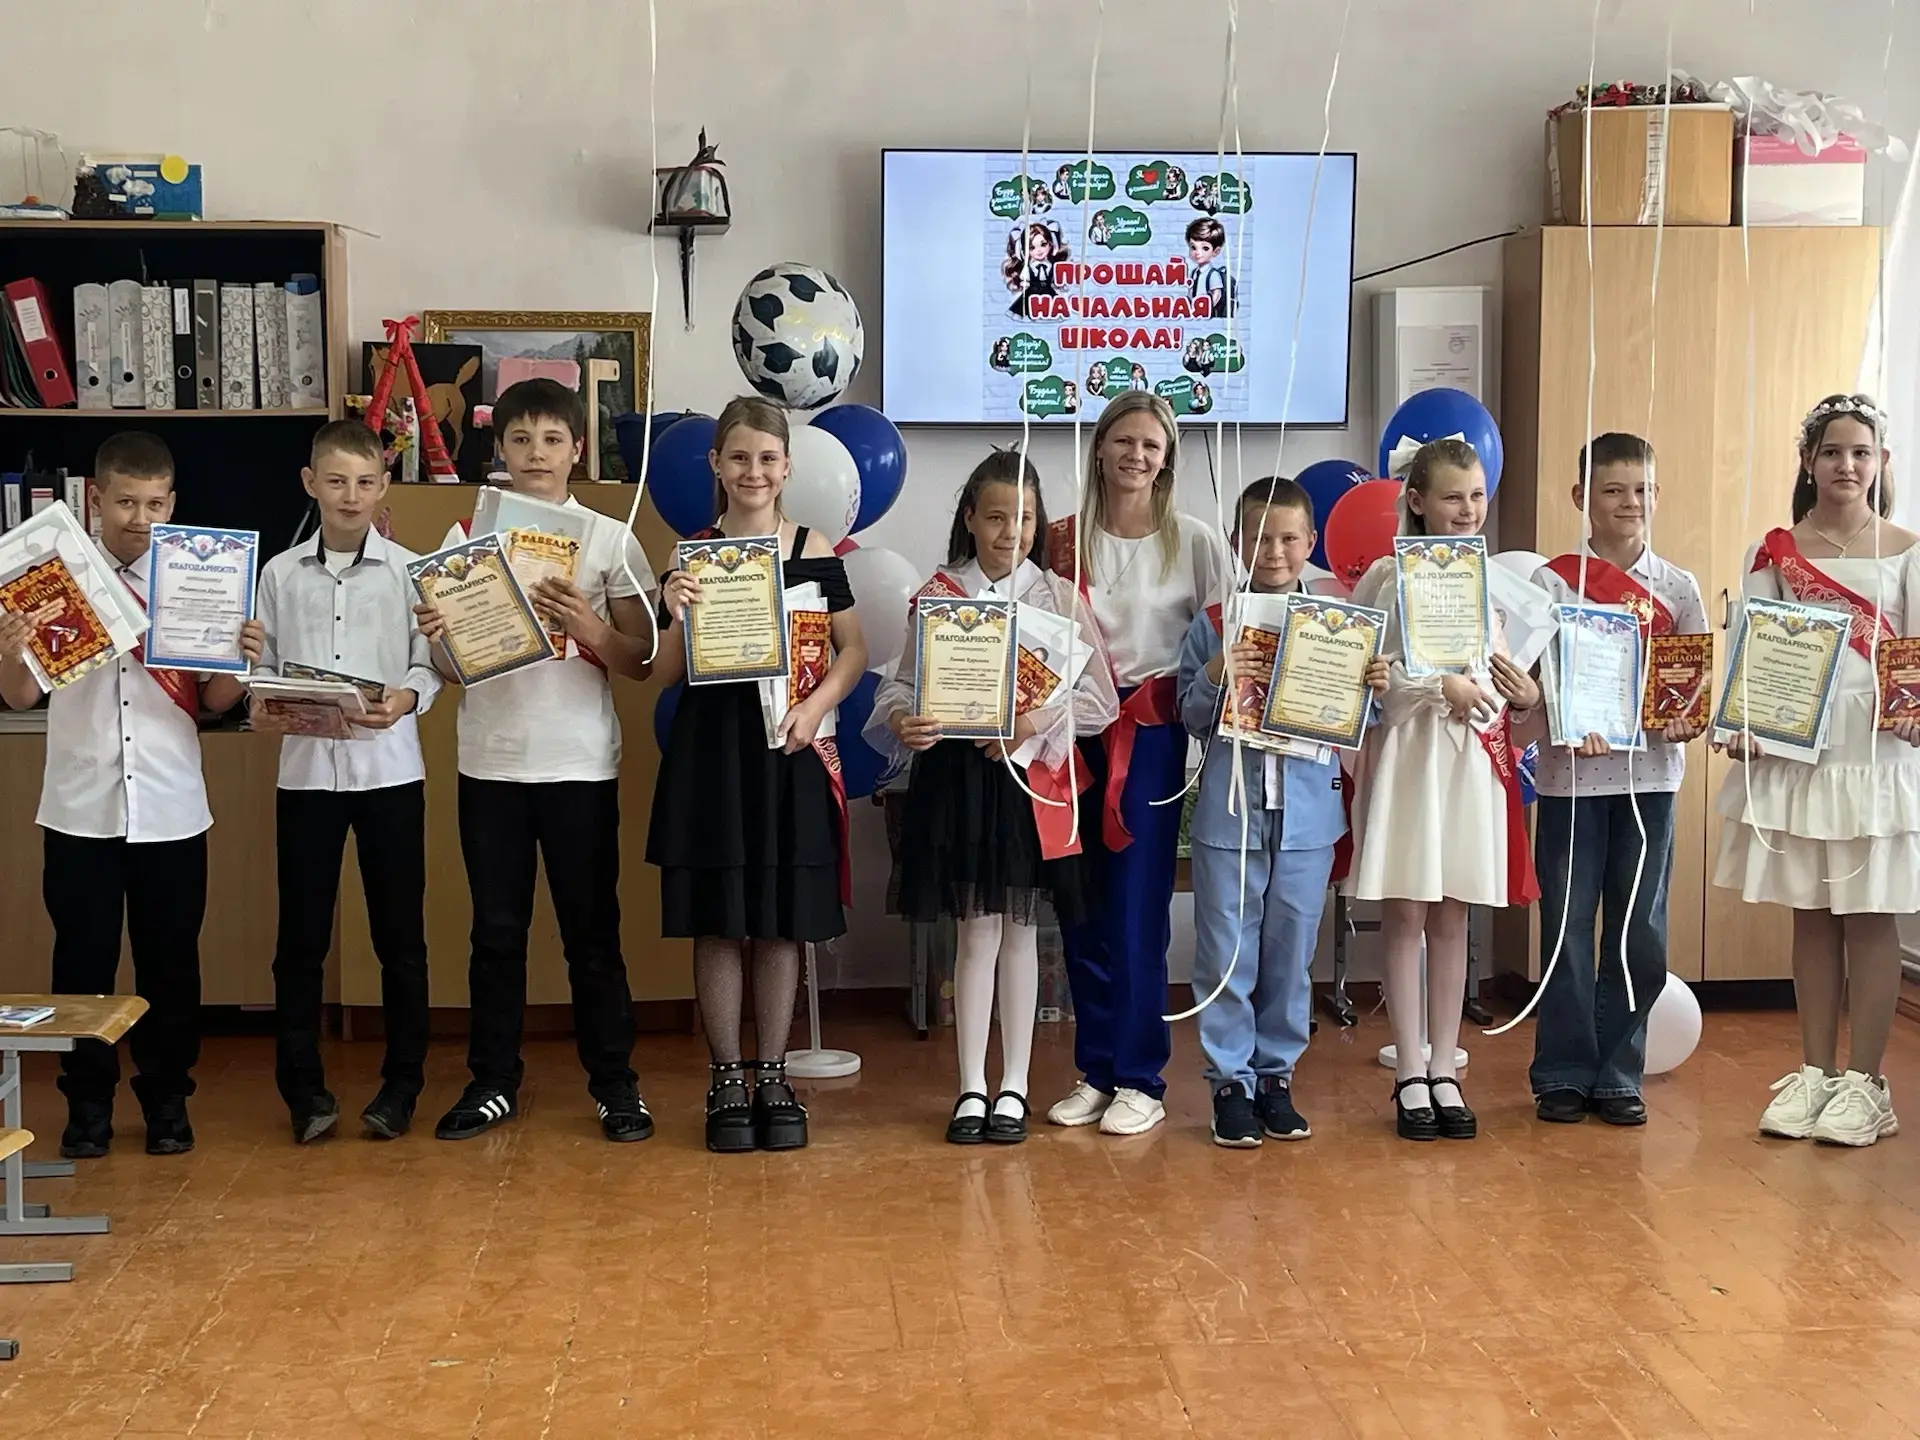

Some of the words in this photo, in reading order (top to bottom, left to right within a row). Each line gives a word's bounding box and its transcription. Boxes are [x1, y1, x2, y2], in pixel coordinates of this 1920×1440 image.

[1055, 256, 1193, 287] ПРОЩАЙ,
[1030, 296, 1211, 319] НАЧАЛЬНАЯ
[1060, 328, 1181, 349] ШКОЛА!
[168, 562, 239, 574] БЛАГОДАРНОСТЬ
[435, 573, 498, 599] БЛАГОДАРНОСТЬ
[699, 573, 766, 585] БЛАГОДАРНОСТЬ
[935, 634, 1002, 644] БЛАГОДАРНОСТЬ
[1299, 631, 1365, 651] БЛАГОДАРНОСТЬ
[1757, 632, 1824, 653] БЛАГОДАРНОСТЬ
[1656, 654, 1702, 664] ДИПЛОМ
